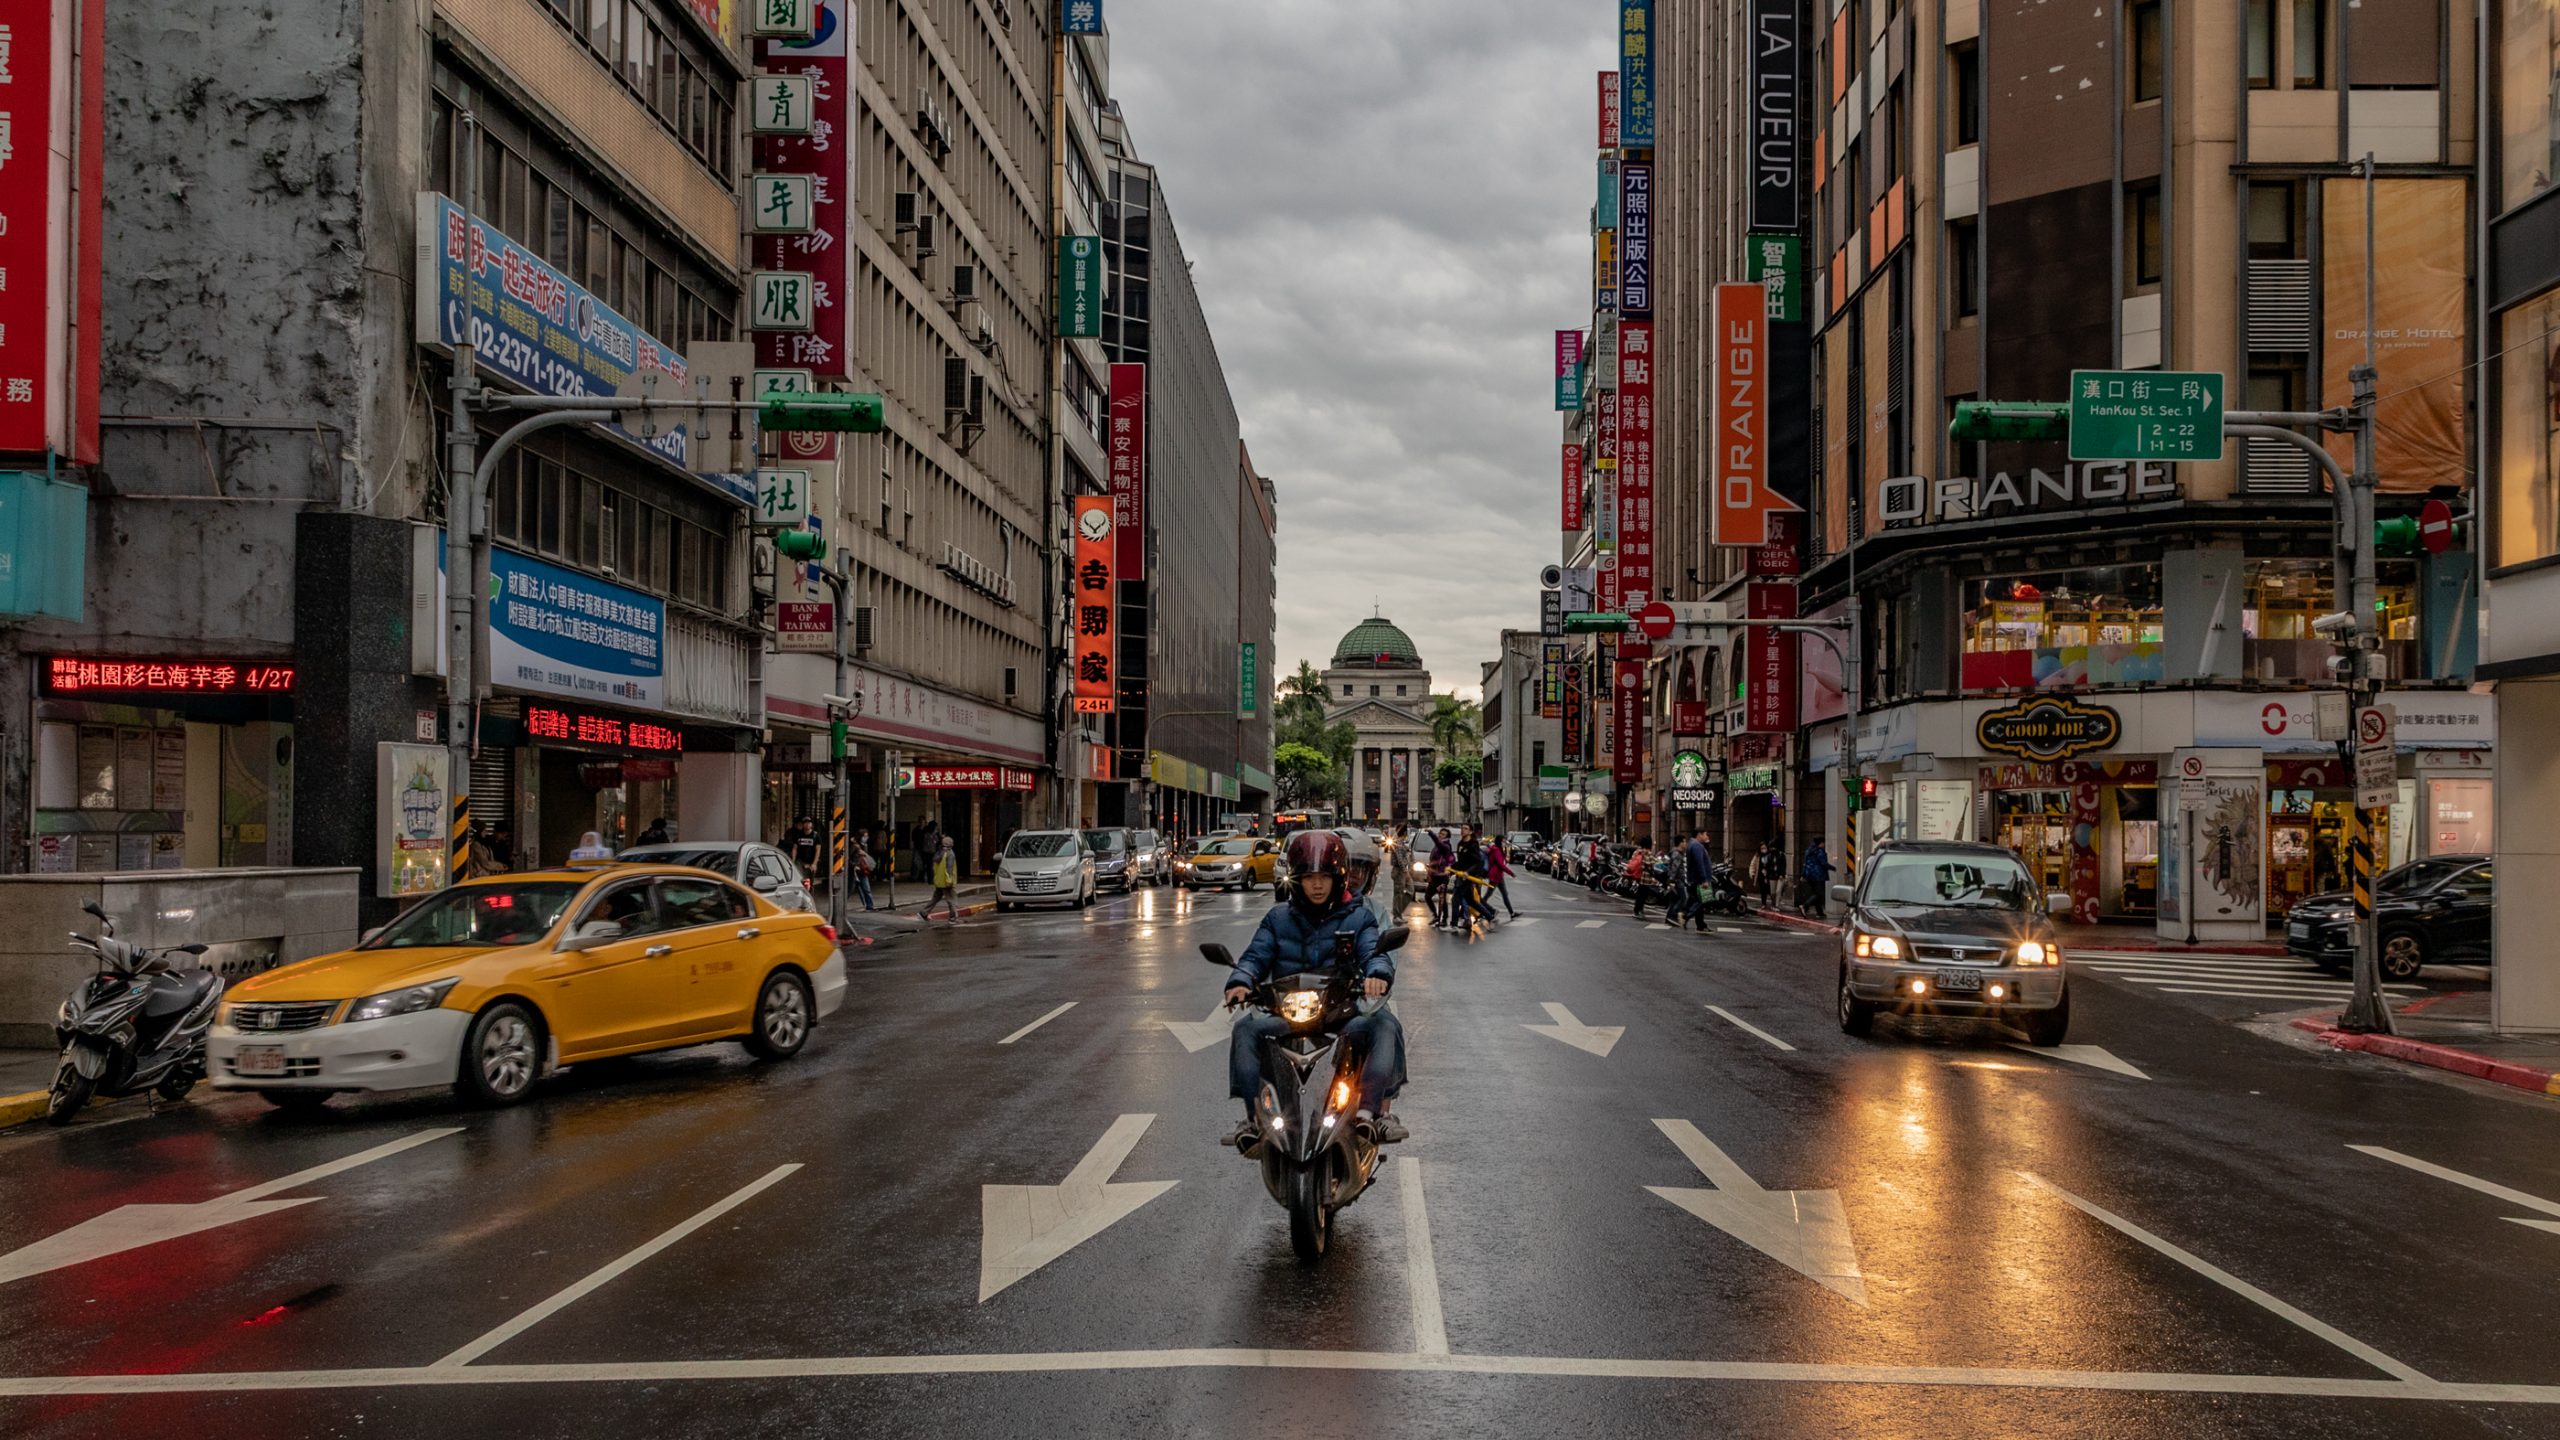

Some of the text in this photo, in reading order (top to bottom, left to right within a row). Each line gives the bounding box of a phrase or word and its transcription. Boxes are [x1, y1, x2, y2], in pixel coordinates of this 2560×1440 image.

[1070, 1, 1095, 22] 券
[1070, 22, 1095, 31] 4F
[1624, 7, 1646, 57] 鎮麟
[1631, 58, 1646, 135] 升大學中心
[1760, 14, 1792, 188] LA LUEUR
[1603, 74, 1619, 145] 戴爾美語
[1625, 169, 1648, 308] 元照出版公司
[592, 314, 633, 367] 中青旅遊
[2406, 328, 2455, 339] HOTEL
[775, 334, 786, 363] Ltd.
[1623, 328, 1649, 385] 高點
[1561, 333, 1577, 395] 三元及第
[2082, 379, 2200, 400] 漢口街一段
[1725, 319, 1753, 509] ORANGE
[2090, 405, 2192, 416] HanKou St. Sec. 1
[1600, 394, 1616, 457] 留學家
[2152, 424, 2162, 436] 2
[2179, 424, 2195, 436] 22
[2150, 440, 2164, 451] 1-1
[2180, 440, 2193, 451] 15
[1114, 417, 1131, 527] 泰安產物保險
[1605, 459, 1615, 468] 6F
[1878, 460, 2176, 521] ORANGE
[1756, 551, 1790, 559] TOEFL
[1757, 560, 1790, 568] TOEIC
[508, 570, 657, 633] 財團法人中國青年服務事業文教基金會
[791, 604, 820, 613] BANK
[784, 621, 827, 631] TAIWAN
[798, 613, 813, 622] OF
[1079, 559, 1110, 684] 吉野家
[78, 662, 295, 689] 桃園彩色海芋季 4/27
[874, 674, 927, 722] 臺灣銀行
[1079, 700, 1109, 711] 24H
[1565, 664, 1579, 745] CAMPUS
[421, 722, 432, 737] 45
[1623, 690, 1634, 767] 上海商業儲蓄銀行
[2005, 722, 2084, 737] GOOD JOB
[919, 770, 995, 782] 臺灣產物保險
[2130, 764, 2147, 777] Air
[1673, 790, 1715, 801] NEOSOHO
[2081, 812, 2097, 823] Air
